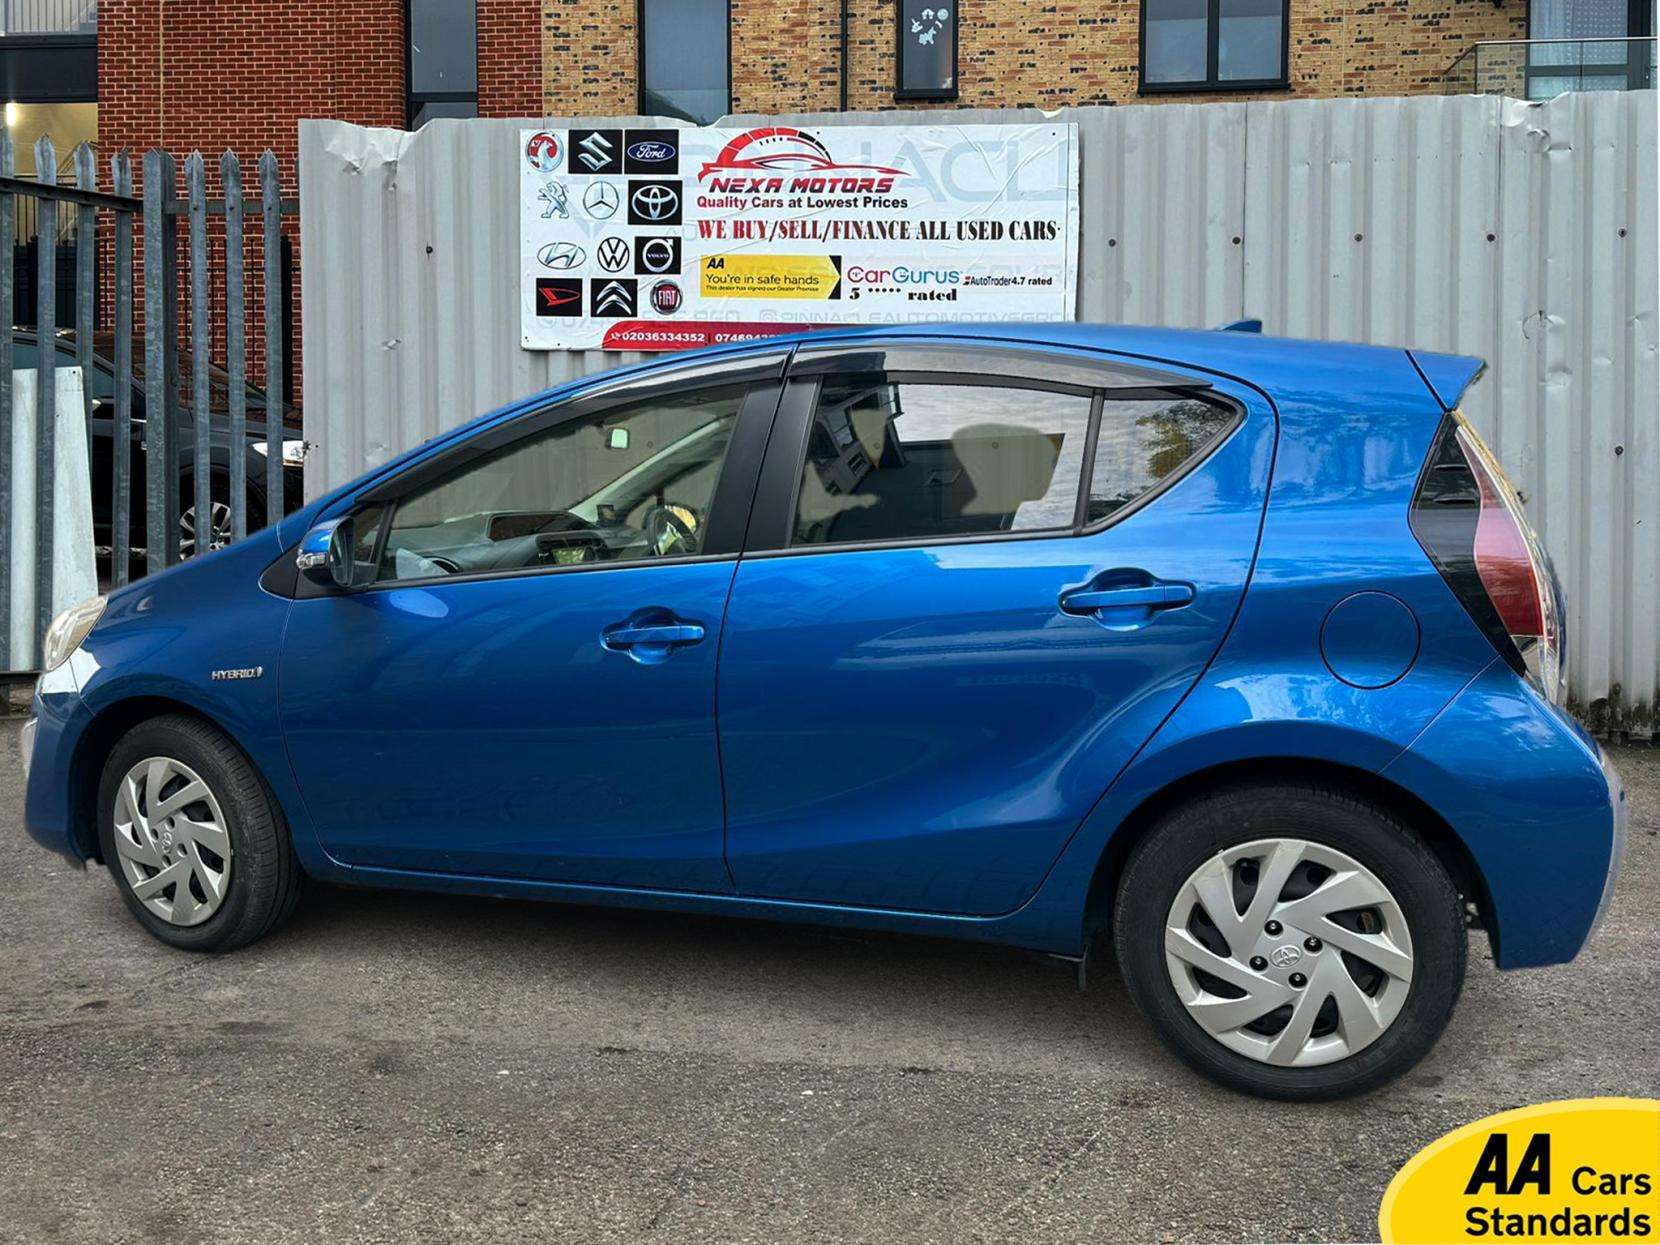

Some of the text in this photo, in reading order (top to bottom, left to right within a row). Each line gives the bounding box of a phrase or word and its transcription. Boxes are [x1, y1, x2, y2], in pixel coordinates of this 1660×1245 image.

[636, 144, 666, 159] Ford
[708, 177, 895, 194] NEXA MOTORS
[697, 196, 908, 210] Quality Cars at Lowest Prices
[697, 220, 727, 240] WE
[916, 220, 951, 241] ALL
[957, 220, 1004, 241] USED
[1009, 220, 1057, 241] CARS
[707, 257, 725, 270] AA
[706, 273, 820, 285] You're in safe hands
[847, 265, 960, 284] CarGurus
[1028, 276, 1053, 286] rated
[658, 290, 676, 306] FIAT
[849, 287, 958, 301] 5 rated
[622, 332, 706, 342] 02036334352
[211, 668, 255, 680] HYBRID
